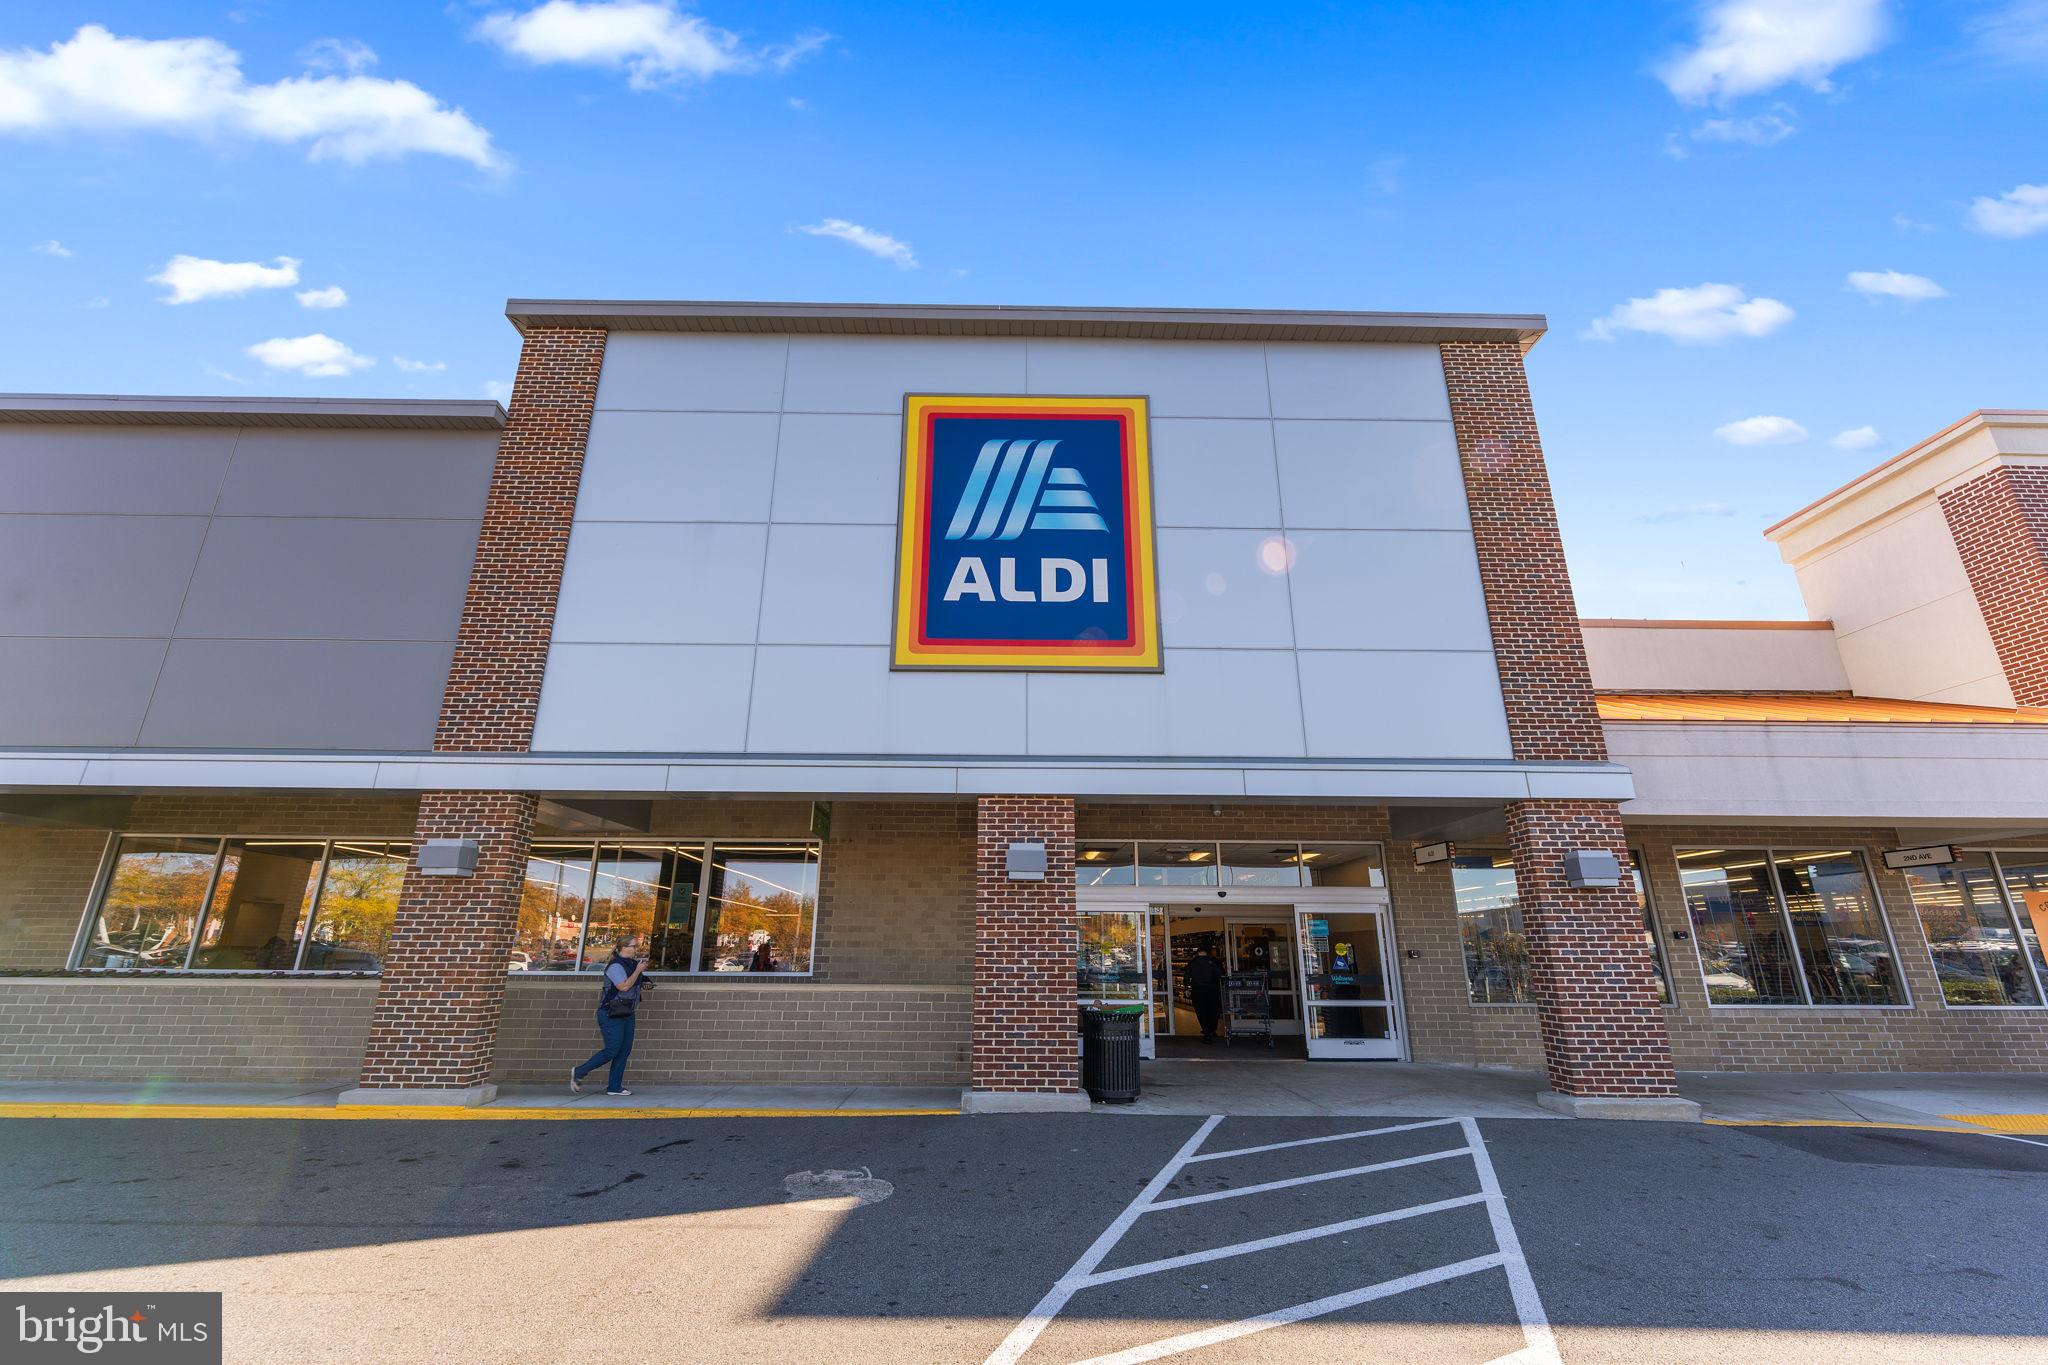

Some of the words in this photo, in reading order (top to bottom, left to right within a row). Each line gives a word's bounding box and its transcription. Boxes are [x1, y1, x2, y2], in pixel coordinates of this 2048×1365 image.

[943, 556, 1109, 603] ALDI
[1903, 854, 1917, 862] 2ND
[1919, 852, 1932, 860] AVE
